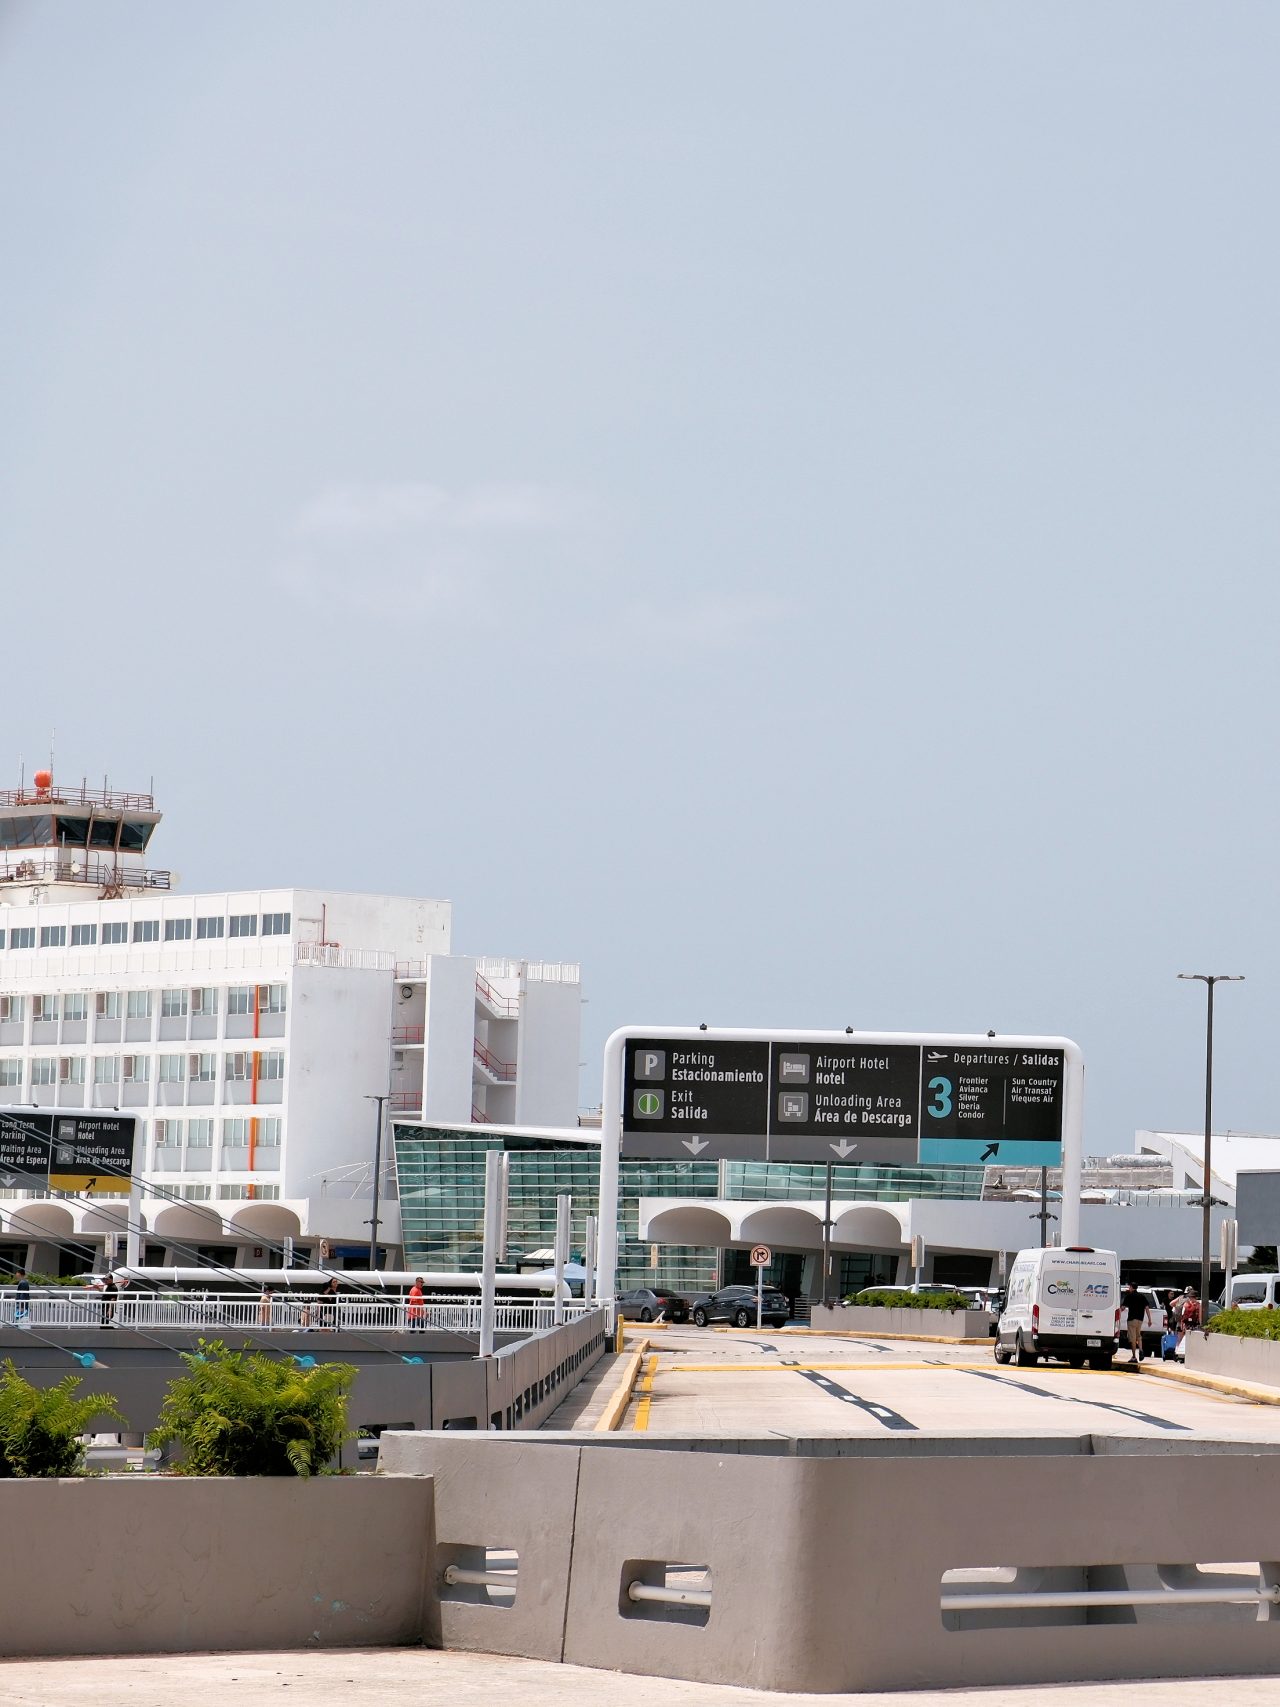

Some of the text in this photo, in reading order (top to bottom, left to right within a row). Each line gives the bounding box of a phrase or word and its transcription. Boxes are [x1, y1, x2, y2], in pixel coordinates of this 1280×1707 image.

[673, 1052, 715, 1068] Parking
[816, 1055, 889, 1071] Airport Hotel
[953, 1052, 1059, 1066] Departures / Salidas
[672, 1068, 764, 1083] Estacionamiento
[816, 1071, 845, 1085] Hotel
[959, 1076, 989, 1085] Frontier
[1012, 1077, 1057, 1088] Sun Country
[959, 1085, 988, 1094] Avianca
[1024, 1087, 1052, 1095] Transat
[671, 1090, 693, 1102] Exit
[927, 1076, 953, 1119] 3
[958, 1094, 979, 1102] Silver
[815, 1094, 901, 1110] Unloading Area
[958, 1102, 980, 1110] Iberia
[671, 1106, 708, 1119] Salida
[814, 1108, 912, 1127] Área de Descarga
[958, 1111, 985, 1119] Condor
[78, 1120, 120, 1131] Airport Hotel
[1, 1131, 26, 1141] Parking
[77, 1131, 95, 1140] Hotel
[0, 1144, 42, 1155] Waiting Area
[77, 1146, 125, 1156] Unloading Area
[16, 1154, 24, 1163] de
[26, 1155, 47, 1166] Espera
[102, 1157, 130, 1167] Descarga
[1047, 1284, 1074, 1295] Charlie
[1084, 1284, 1109, 1294] ACE
